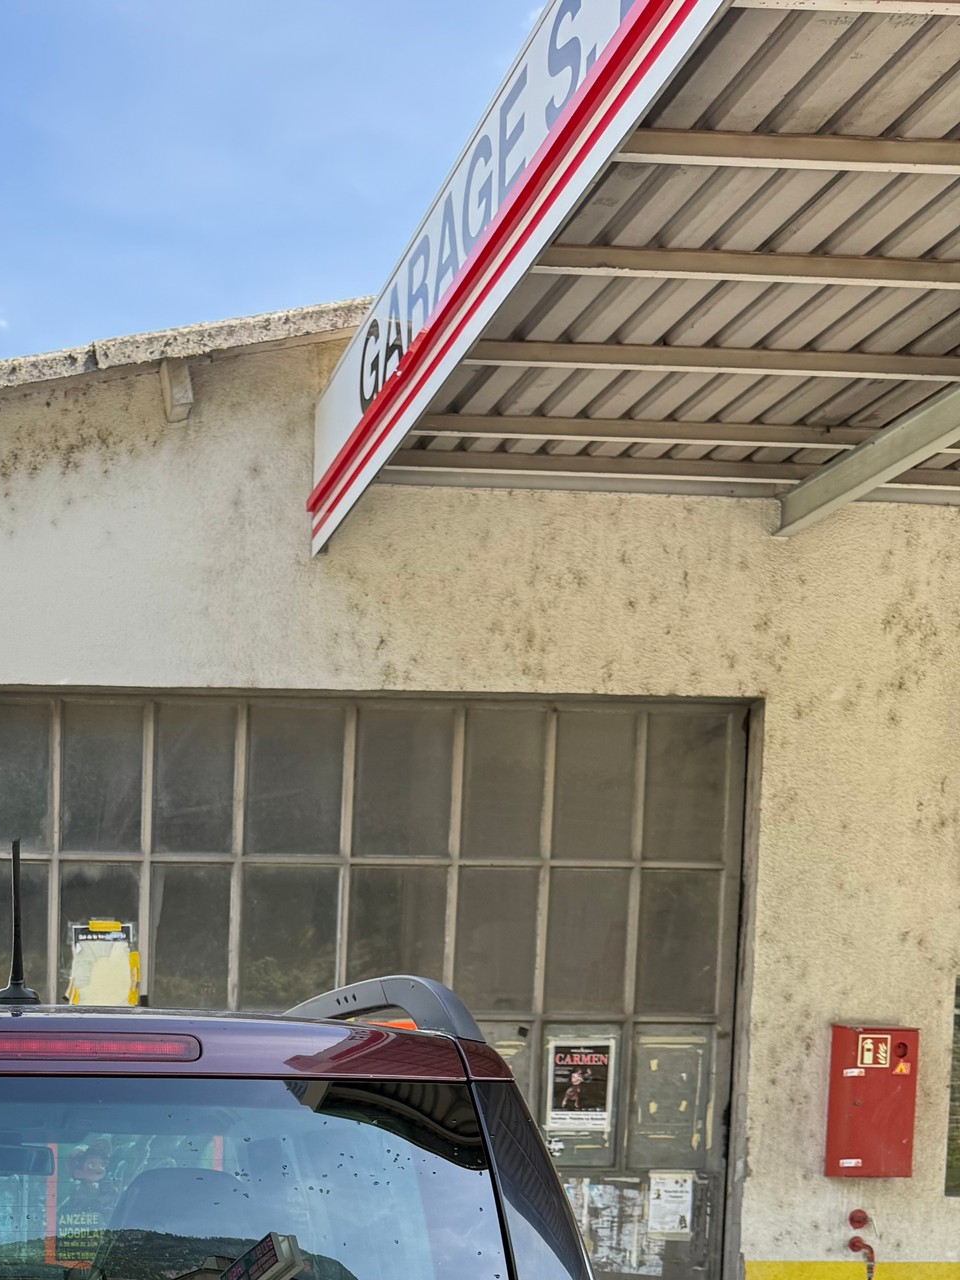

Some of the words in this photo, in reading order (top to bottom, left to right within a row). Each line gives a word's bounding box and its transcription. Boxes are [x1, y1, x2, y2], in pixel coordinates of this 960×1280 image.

[359, 62, 528, 416] GARAGE
[555, 1053, 608, 1066] CARMEN
[59, 1211, 99, 1225] ANZÈRE
